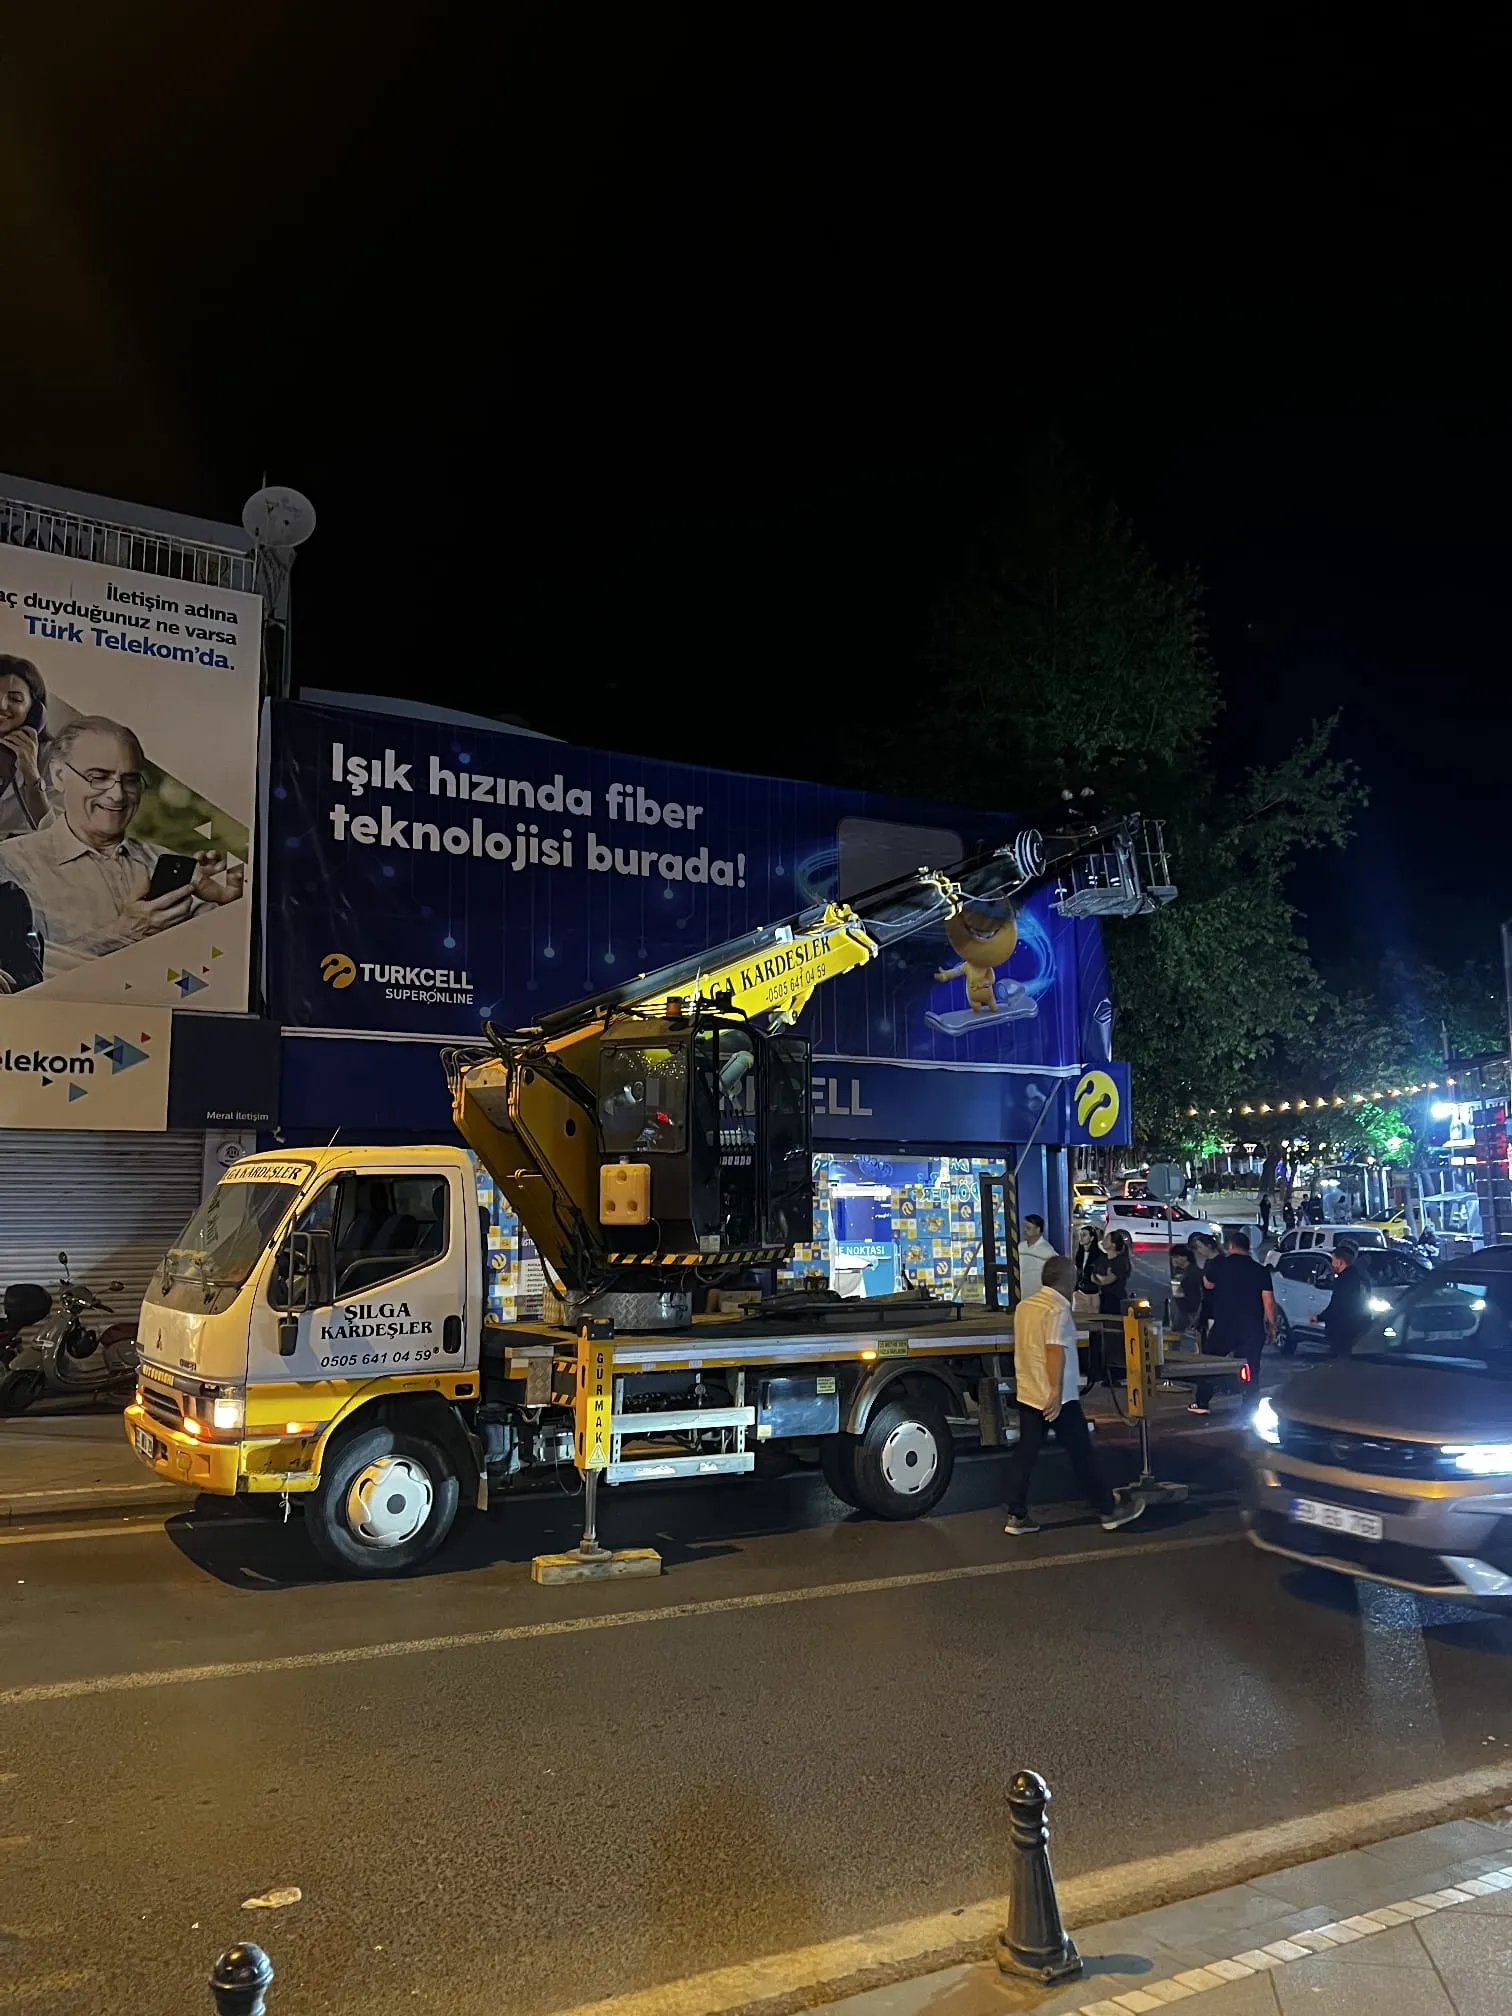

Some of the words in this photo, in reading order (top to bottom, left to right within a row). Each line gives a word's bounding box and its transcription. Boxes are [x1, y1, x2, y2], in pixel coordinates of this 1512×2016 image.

[106, 582, 179, 613] İletişim
[184, 602, 238, 624] adına
[23, 592, 151, 630] duyduğunuz
[156, 618, 180, 635] ne
[185, 625, 237, 645] varsa
[23, 614, 84, 643] Türk
[331, 742, 414, 797] Işık
[429, 755, 592, 817] hızında
[605, 782, 704, 830] fiber
[329, 804, 573, 872] teknolojisi
[587, 832, 746, 888] burada!
[360, 963, 474, 990] TURKCELL
[385, 987, 474, 1005] SUPERONLINE
[0, 1049, 94, 1074] lekom
[206, 1111, 233, 1121] Meral
[344, 1302, 411, 1326] ŞILGA
[321, 1321, 433, 1340] KARDEŞLER
[320, 1354, 357, 1368] 0505
[362, 1352, 387, 1365] 641
[393, 1351, 410, 1363] 04
[414, 1350, 432, 1361] 59
